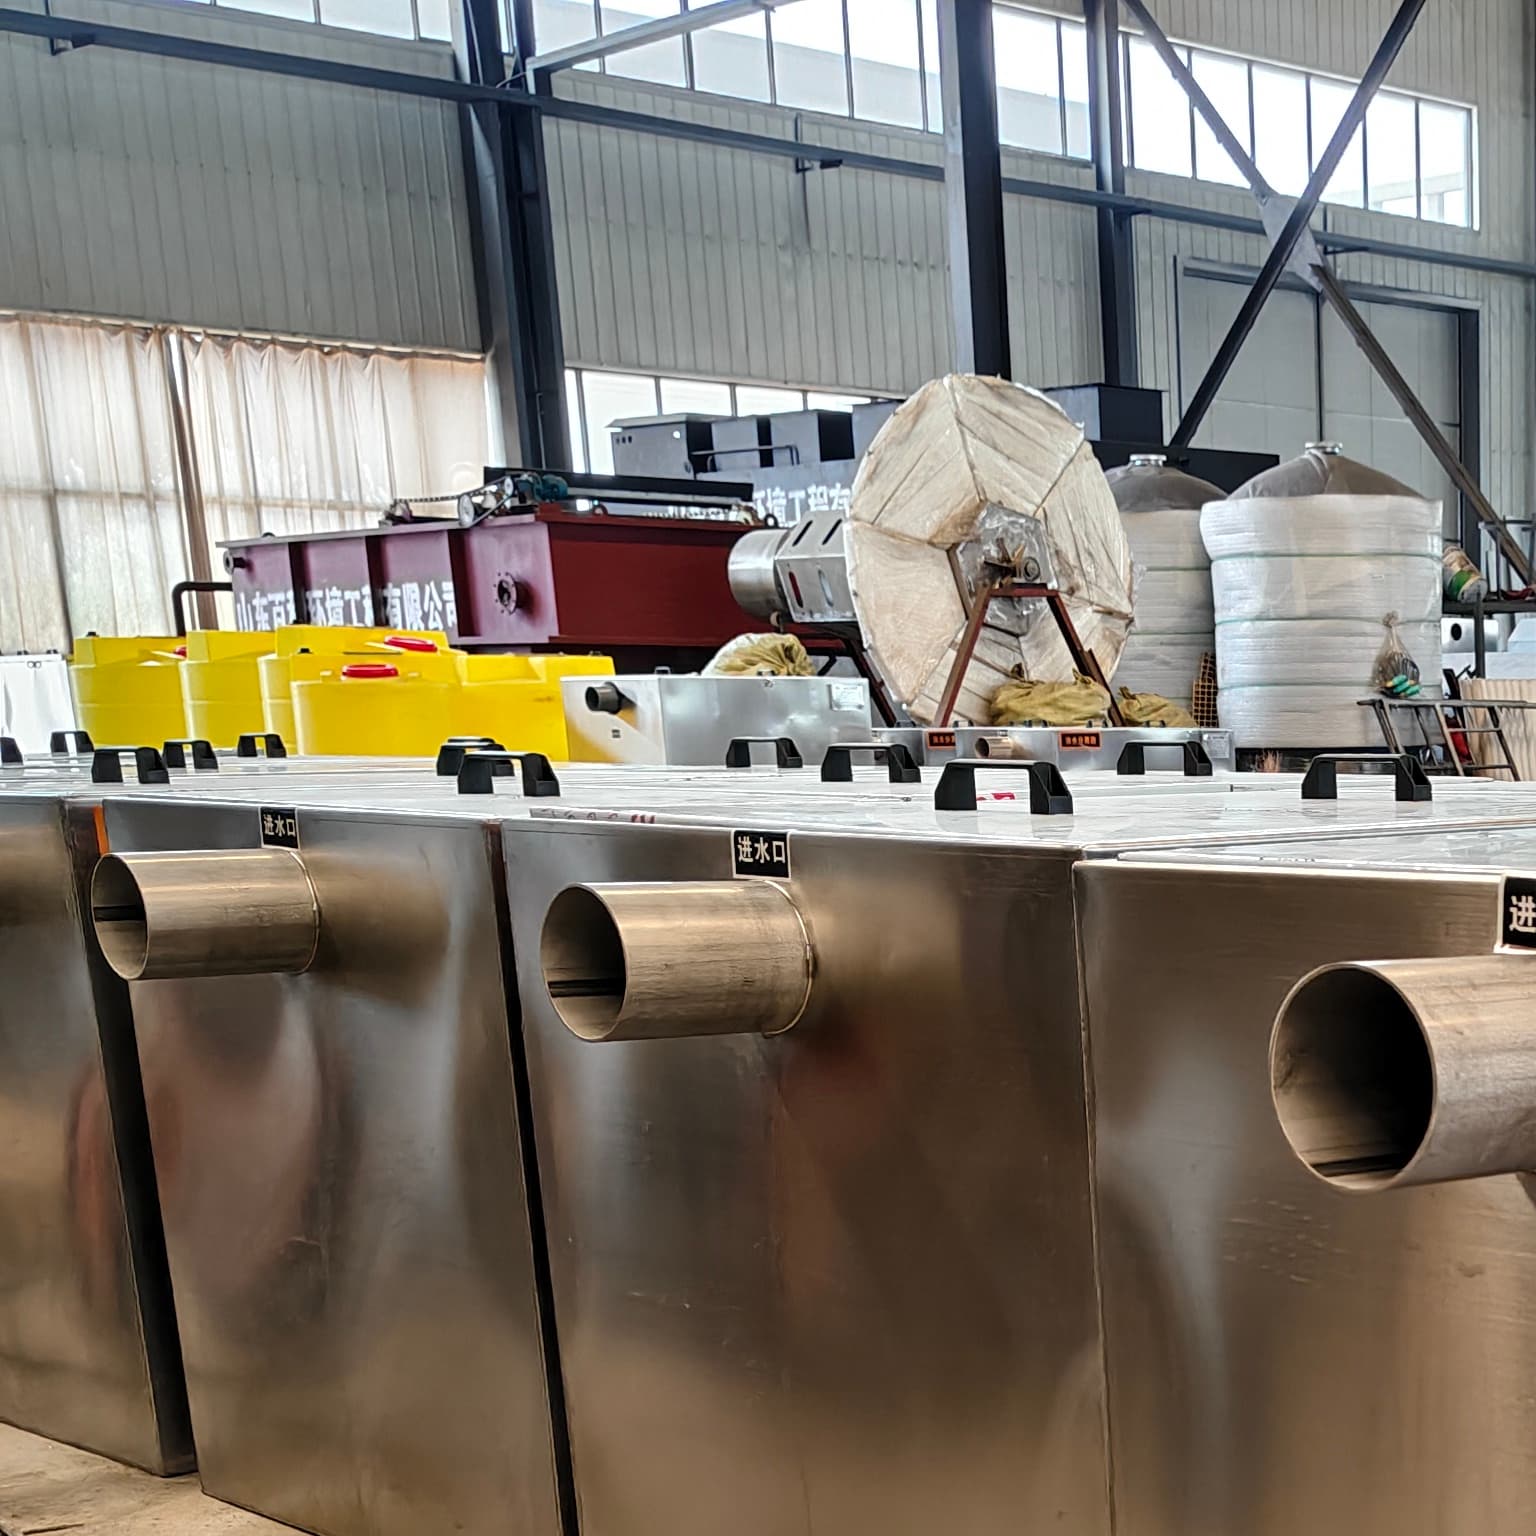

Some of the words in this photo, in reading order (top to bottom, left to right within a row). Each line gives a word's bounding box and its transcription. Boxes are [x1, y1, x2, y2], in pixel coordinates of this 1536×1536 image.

[263, 814, 296, 837] 进水口
[737, 836, 786, 863] 进水口
